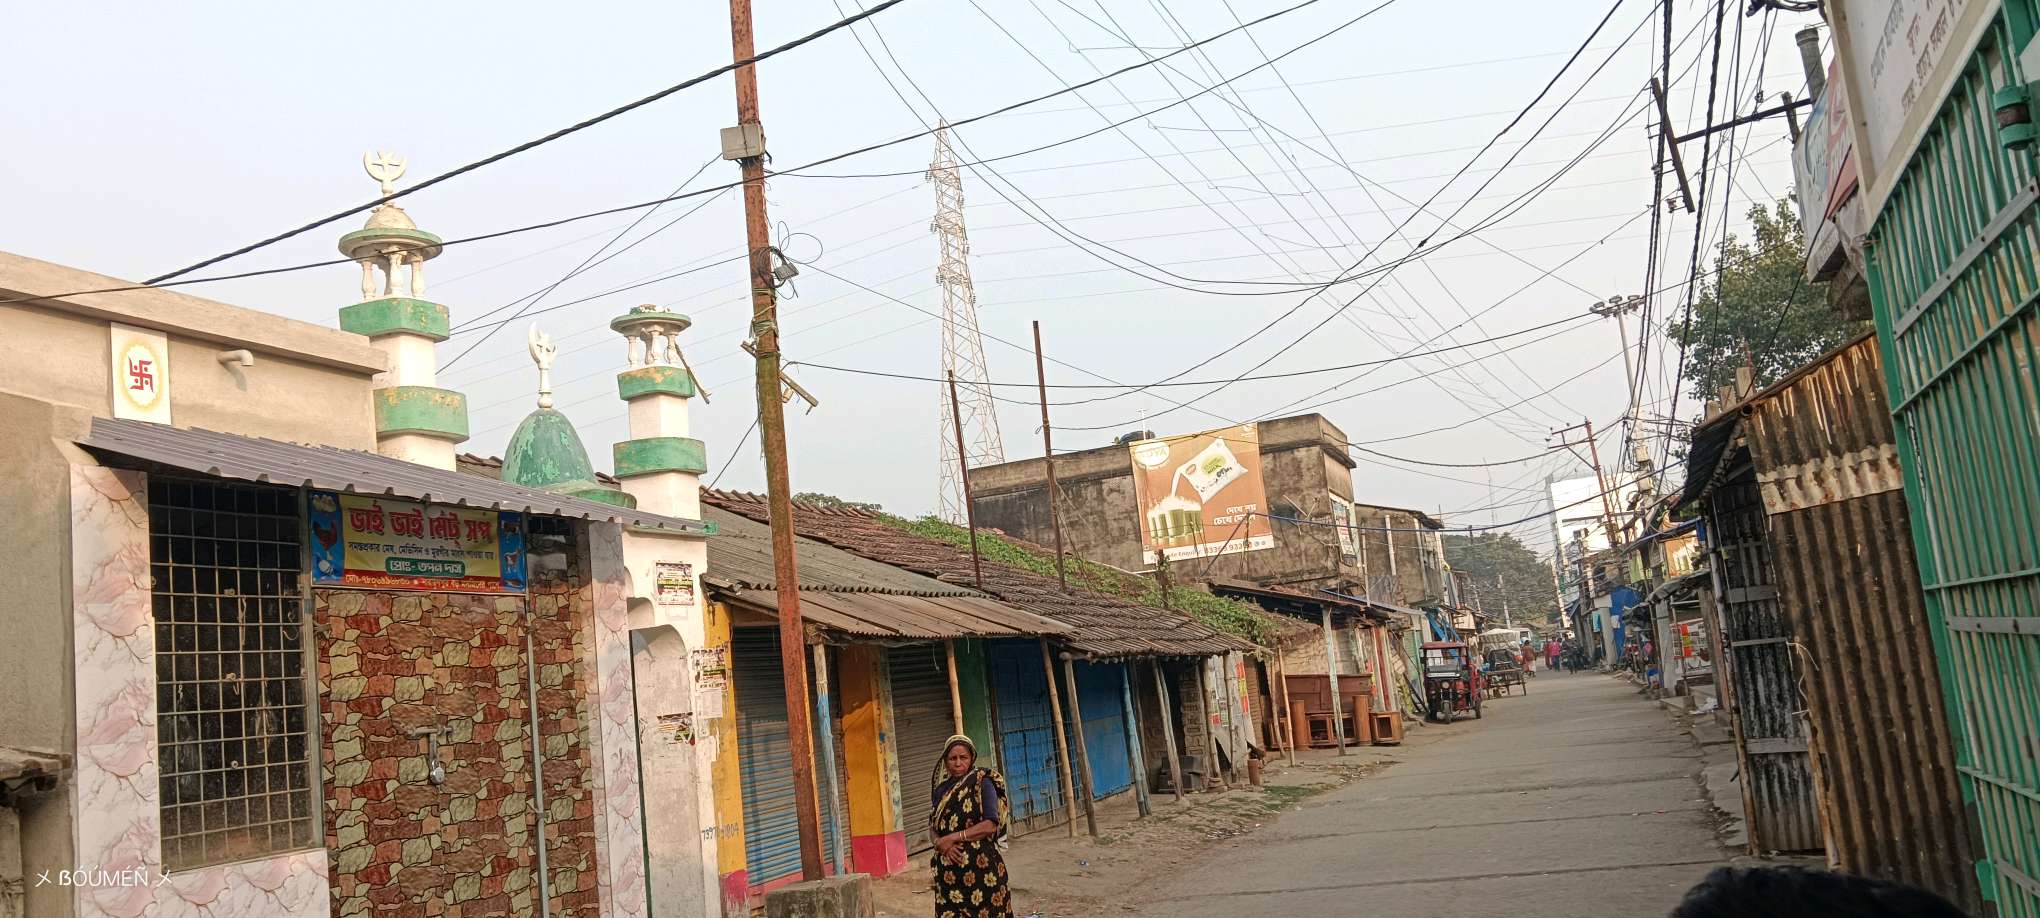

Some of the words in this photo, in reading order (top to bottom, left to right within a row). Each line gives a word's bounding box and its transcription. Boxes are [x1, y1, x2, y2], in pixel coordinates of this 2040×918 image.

[349, 504, 385, 536] ভাই
[388, 508, 424, 539] ভাই
[417, 562, 443, 574] তপন
